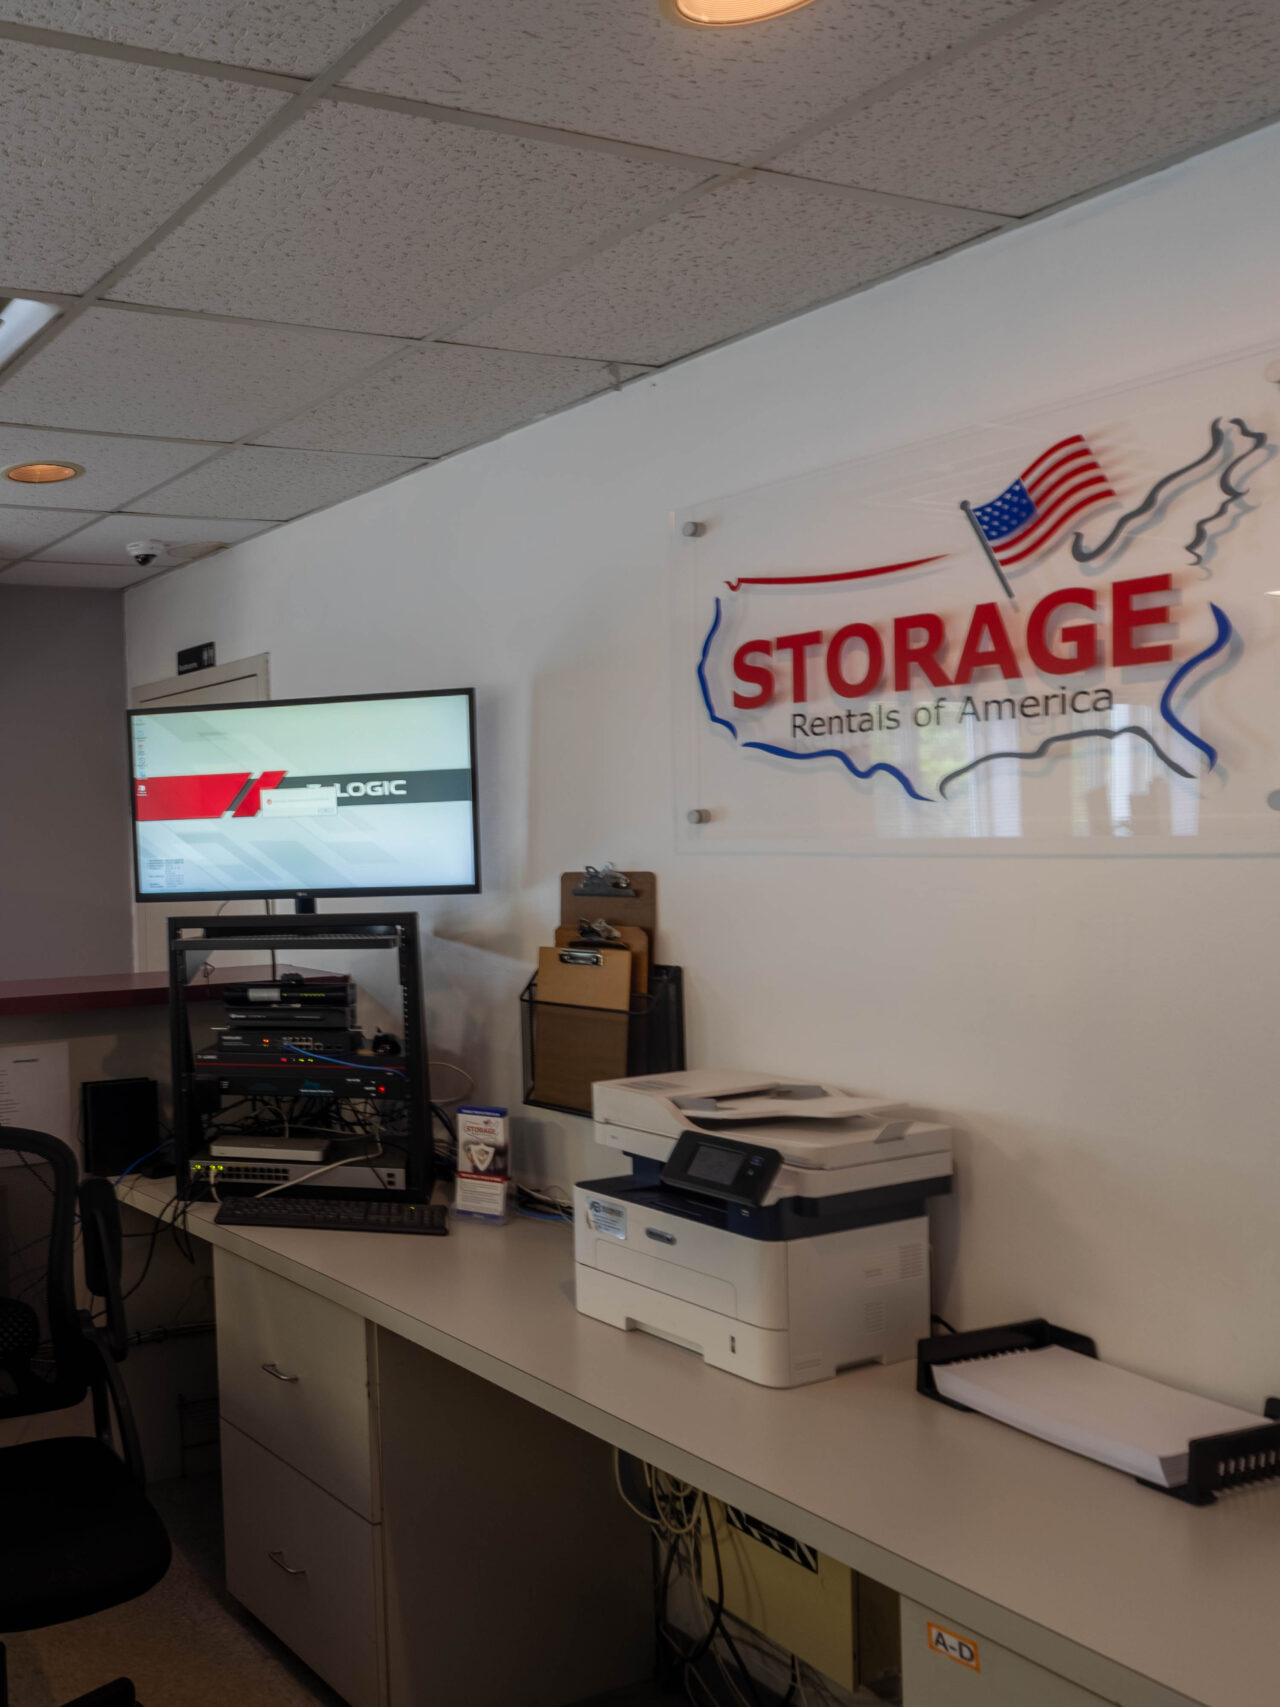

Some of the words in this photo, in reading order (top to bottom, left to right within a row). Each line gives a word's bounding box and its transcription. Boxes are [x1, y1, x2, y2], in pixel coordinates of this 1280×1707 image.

[732, 573, 1173, 710] STORAGE
[791, 702, 901, 739] Rentals
[914, 697, 946, 728] of
[958, 684, 1114, 724] America
[306, 780, 407, 797] LOGIC
[934, 1631, 974, 1662] A-D
